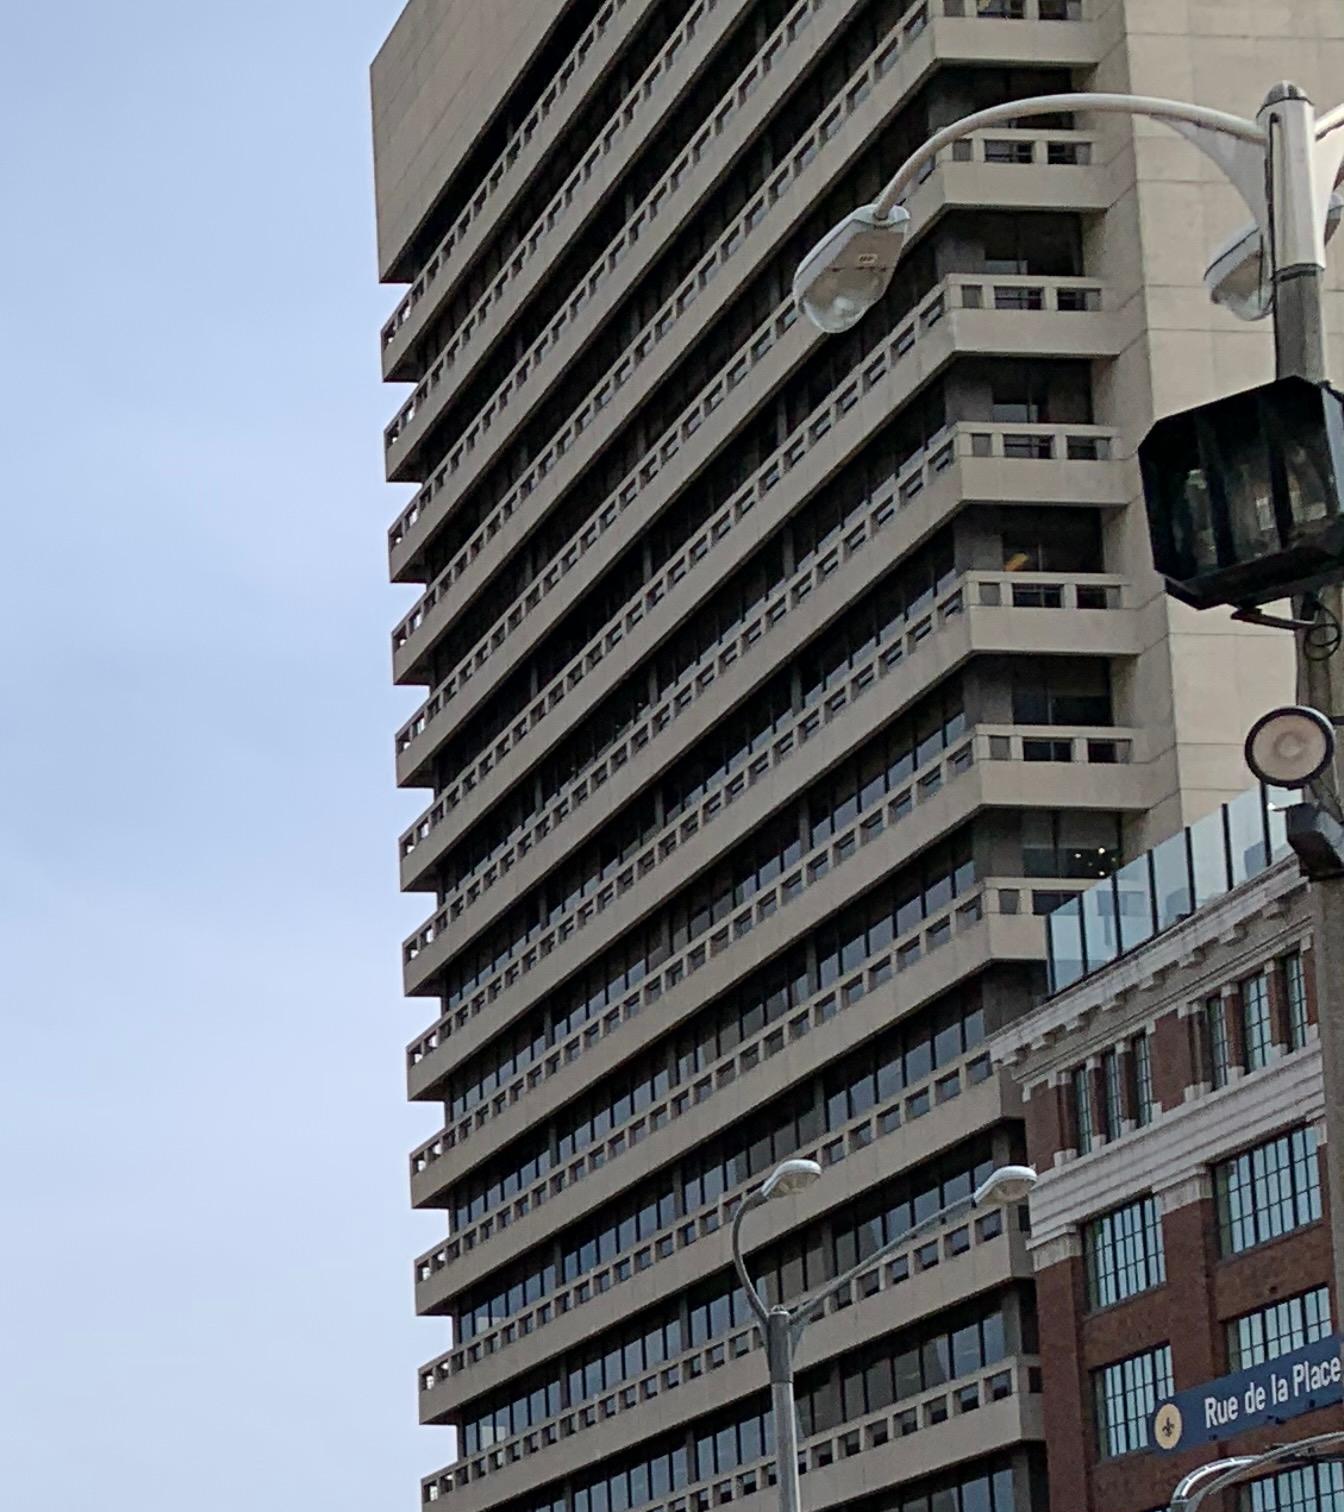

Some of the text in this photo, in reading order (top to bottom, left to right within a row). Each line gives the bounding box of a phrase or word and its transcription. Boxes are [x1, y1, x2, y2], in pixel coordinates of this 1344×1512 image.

[1204, 1356, 1342, 1429] Rue de la Place
